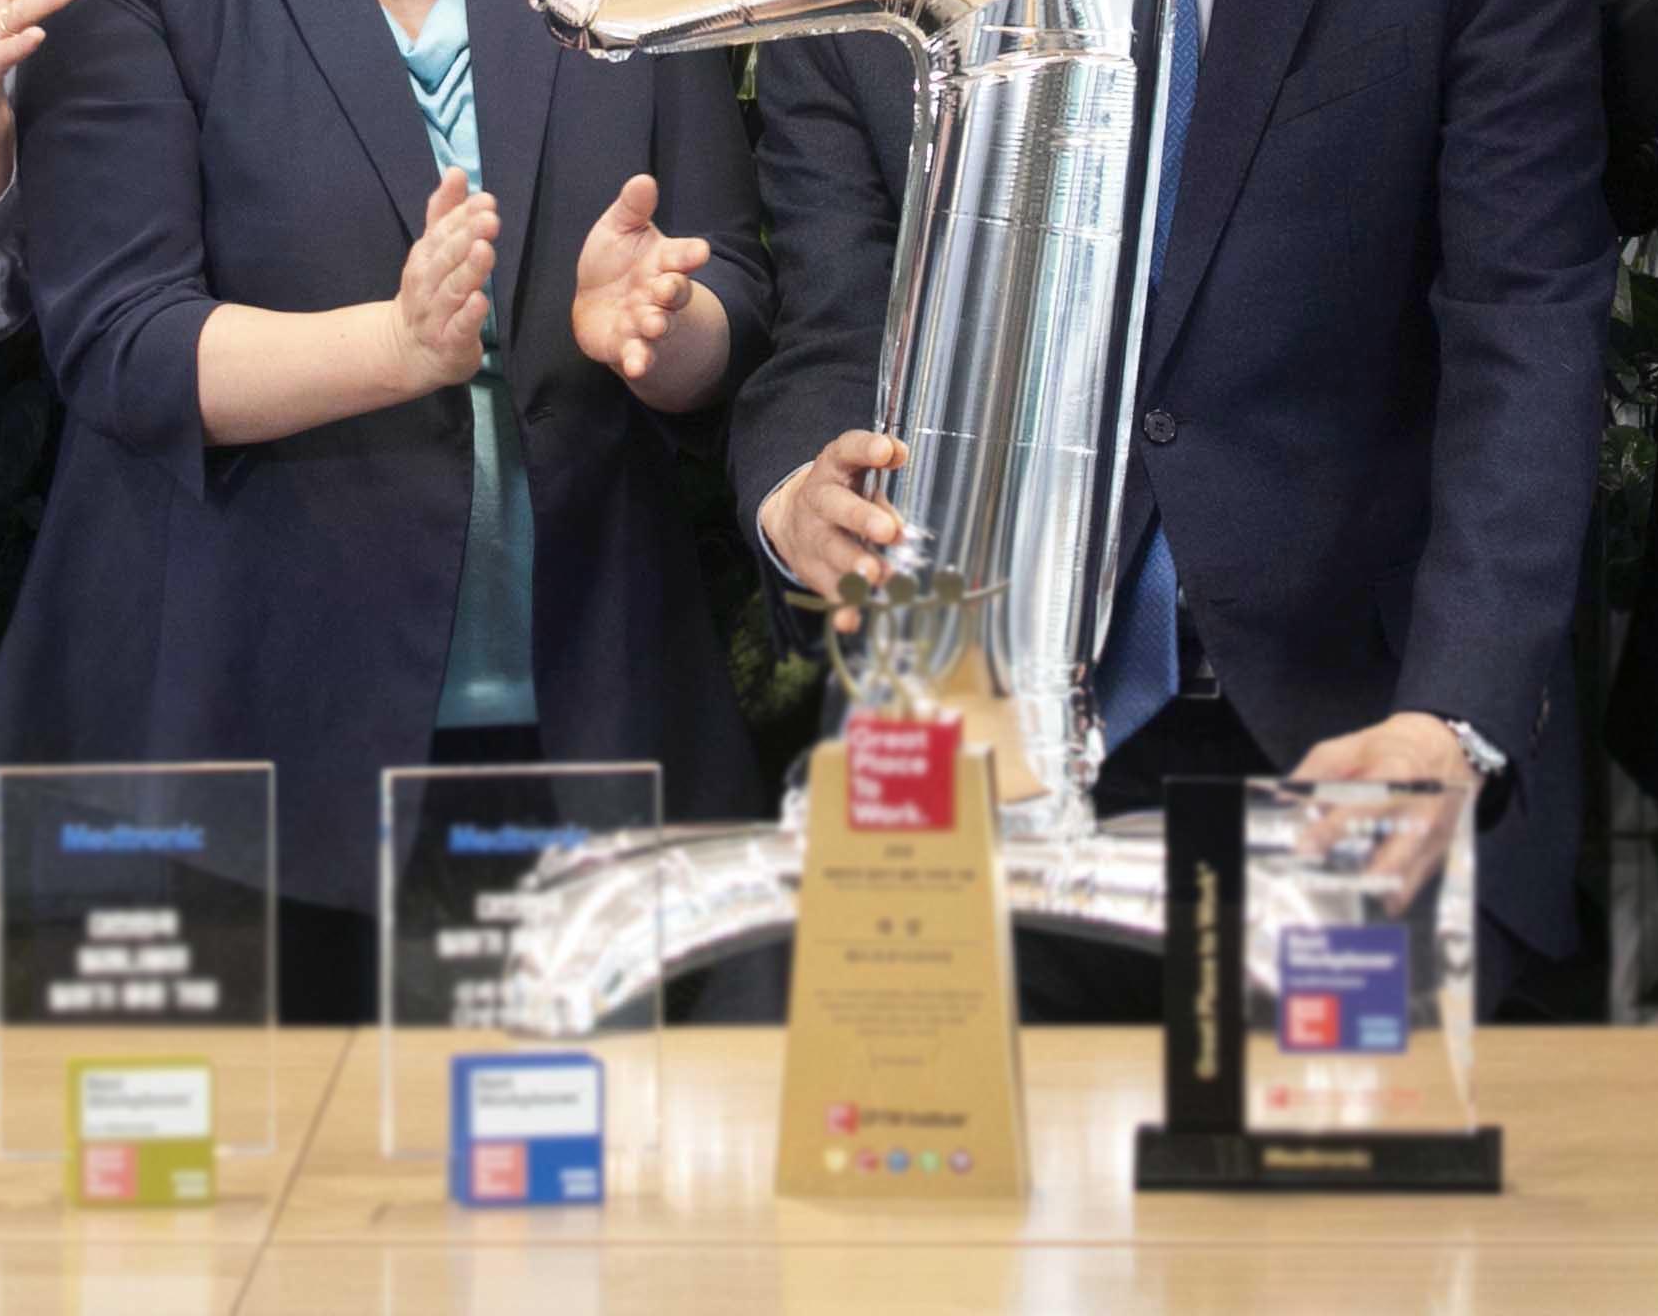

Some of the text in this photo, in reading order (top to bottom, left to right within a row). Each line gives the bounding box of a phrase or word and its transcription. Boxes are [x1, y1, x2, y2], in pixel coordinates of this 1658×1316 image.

[850, 726, 931, 751] Great
[853, 751, 929, 777] Place
[61, 820, 205, 852] Medtronic
